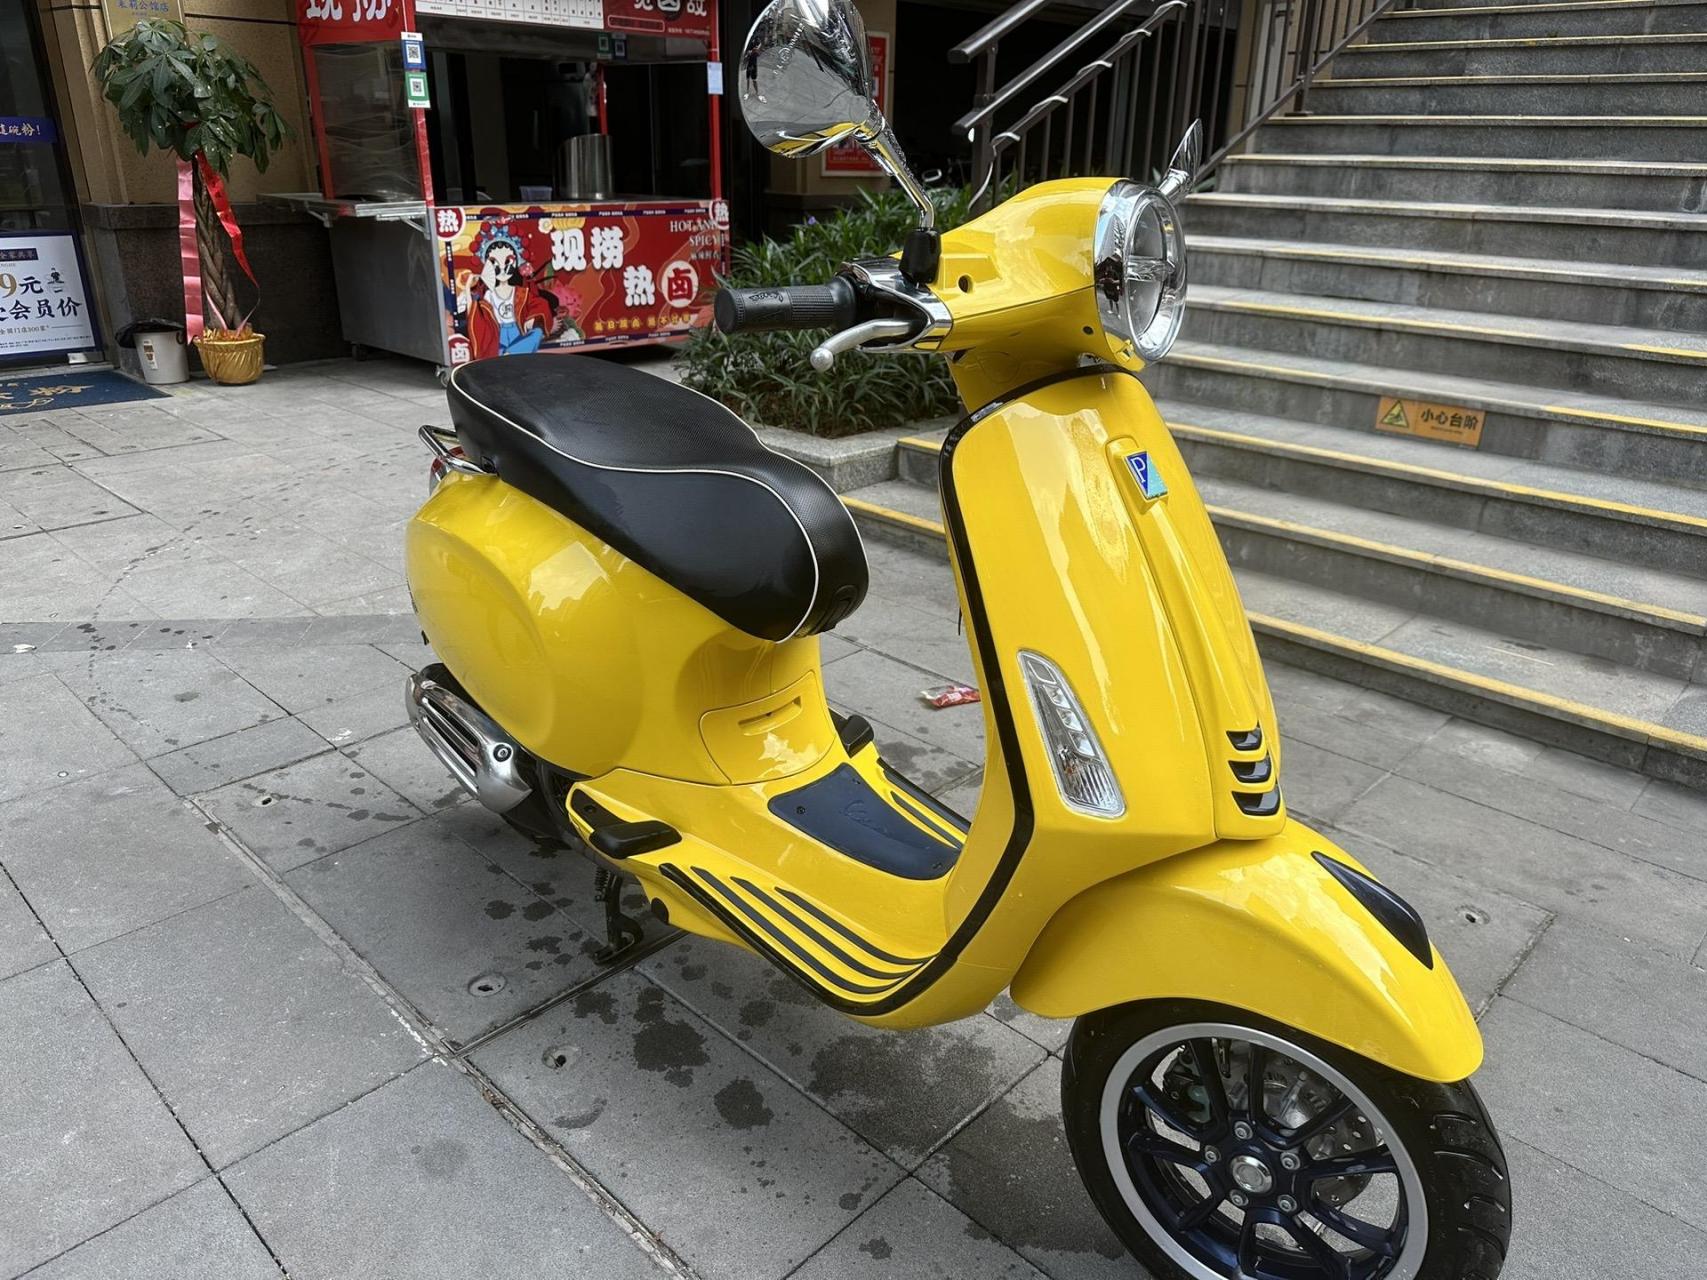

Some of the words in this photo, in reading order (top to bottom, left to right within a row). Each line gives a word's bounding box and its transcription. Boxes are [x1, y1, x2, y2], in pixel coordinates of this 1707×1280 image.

[437, 209, 459, 233] 热
[670, 219, 693, 232] HOT
[551, 226, 624, 271] 现捞
[1420, 408, 1479, 430] 小心台阶
[1131, 457, 1146, 483] P
